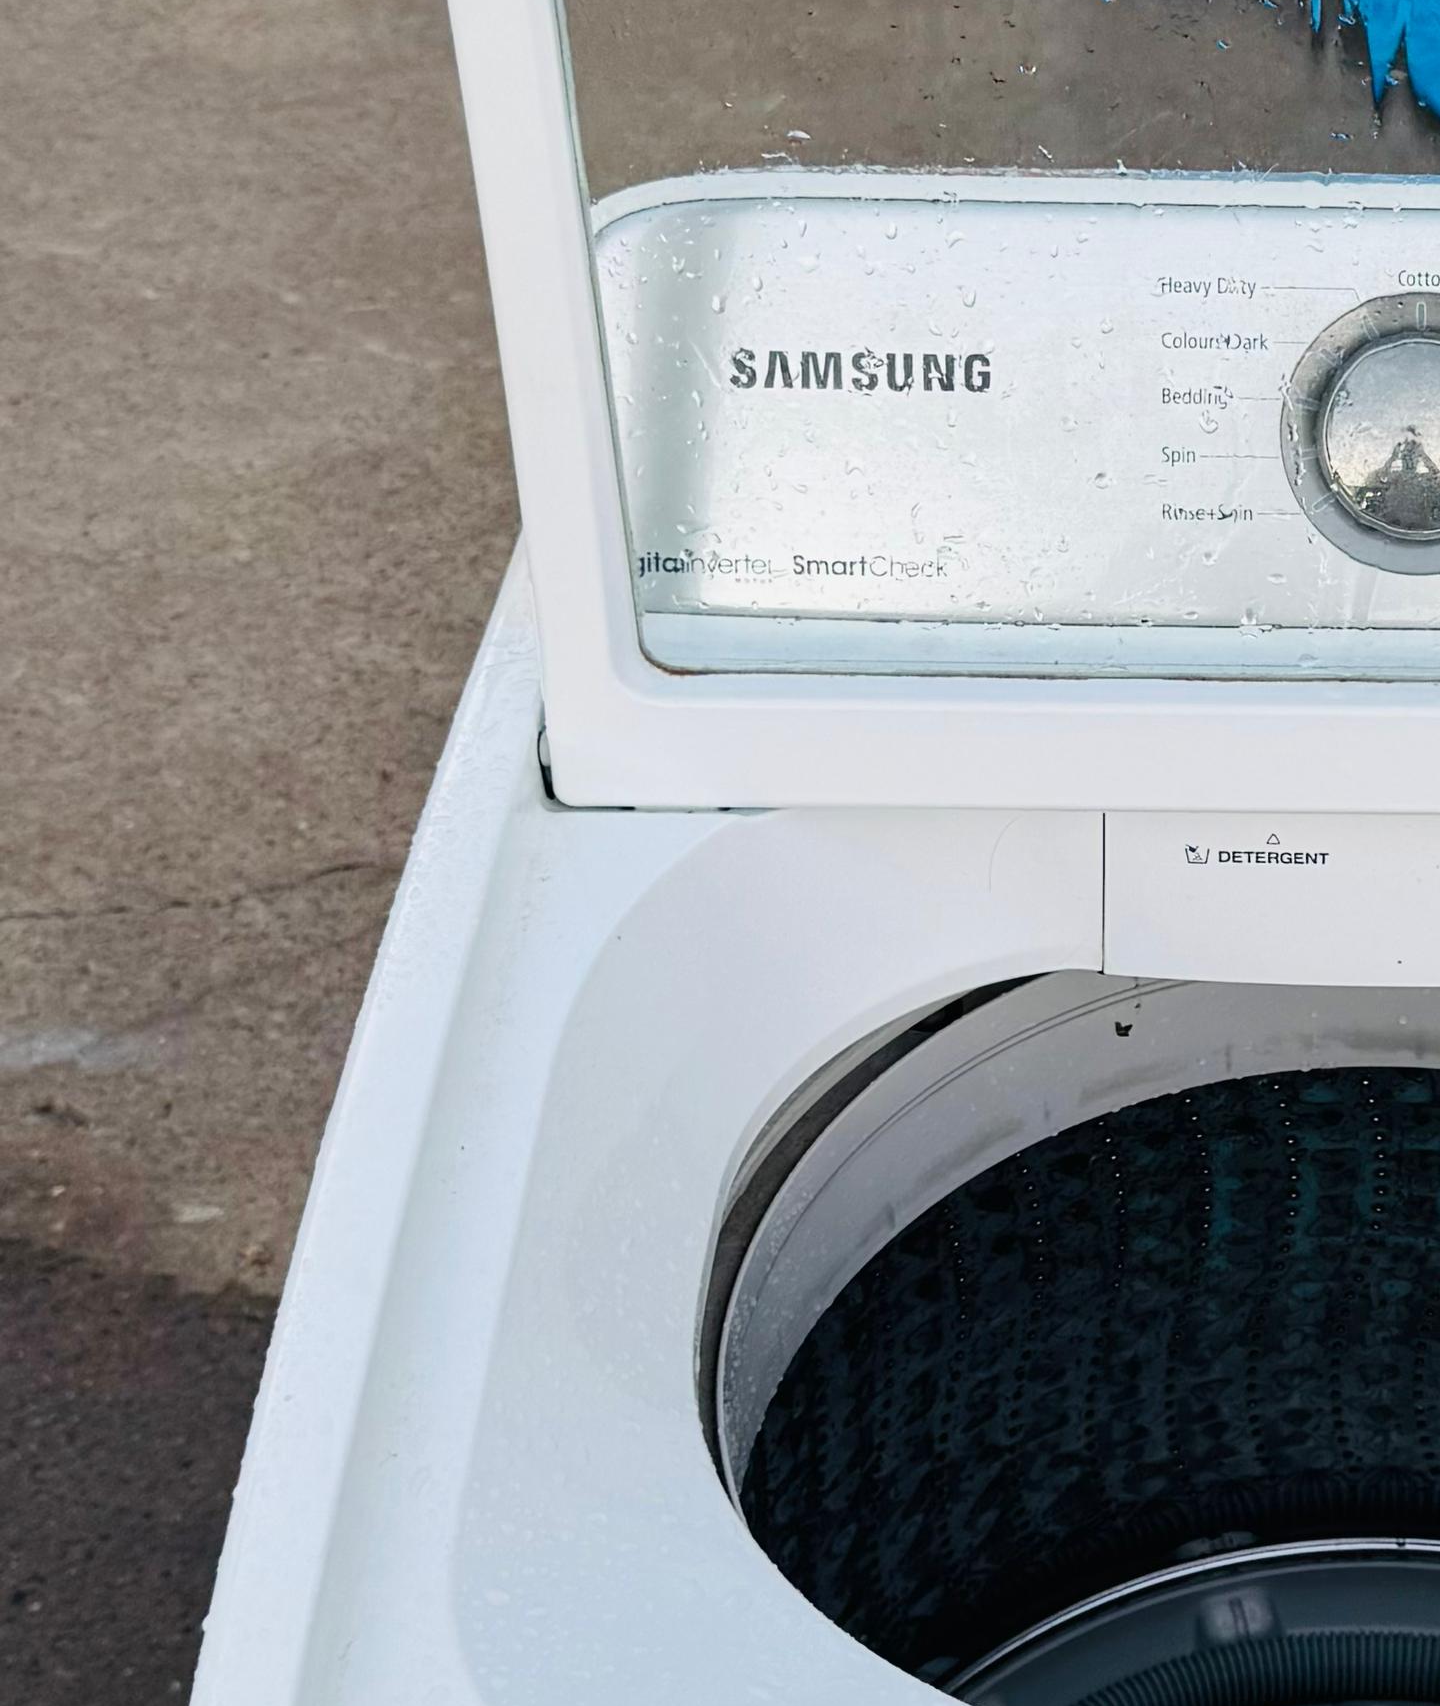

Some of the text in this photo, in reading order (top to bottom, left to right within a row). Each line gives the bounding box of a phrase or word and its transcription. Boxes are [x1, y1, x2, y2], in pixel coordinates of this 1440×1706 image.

[1160, 276, 1211, 301] Heavy
[728, 348, 992, 393] SAMSUNG
[1161, 387, 1229, 410] Bedding
[1161, 446, 1197, 466] Spin
[1217, 850, 1330, 866] DETERGENT
